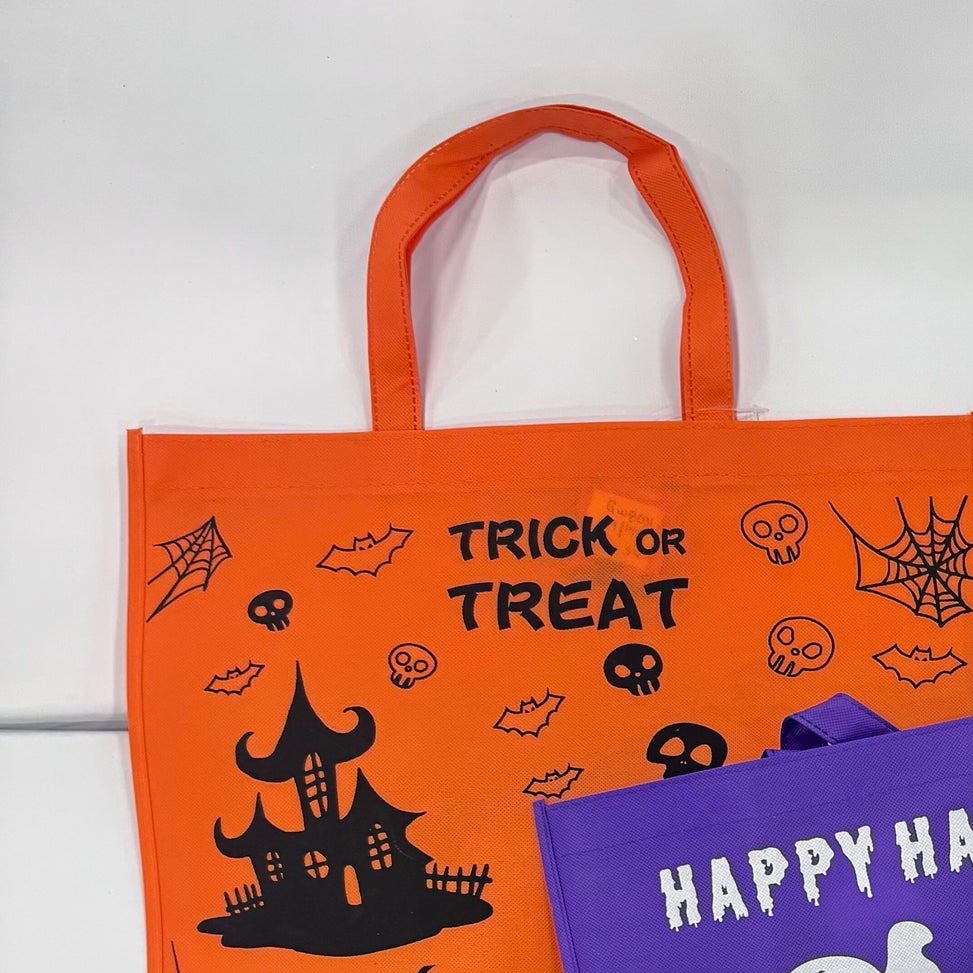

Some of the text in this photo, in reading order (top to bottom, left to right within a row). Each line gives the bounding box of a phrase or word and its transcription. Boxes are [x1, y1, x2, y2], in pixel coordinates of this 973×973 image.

[448, 515, 617, 561] TRICK
[635, 528, 687, 556] OR
[447, 577, 689, 632] TREAT
[659, 825, 874, 931] HAPPY
